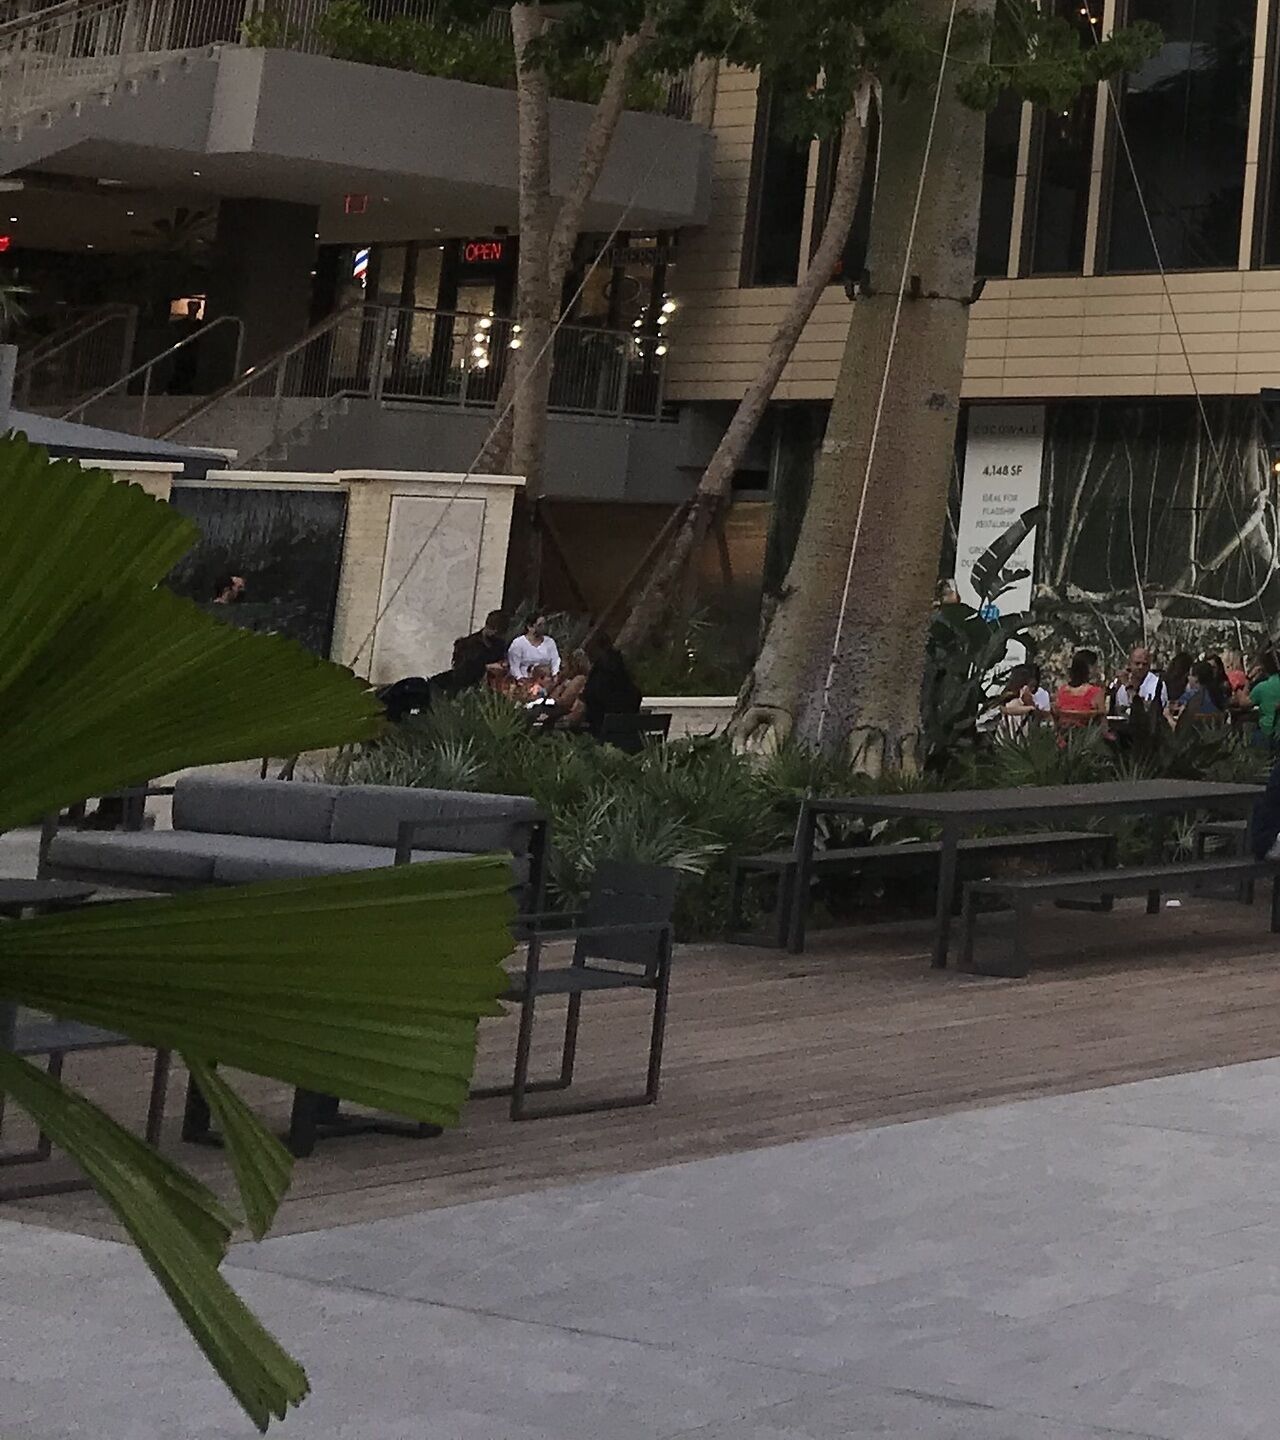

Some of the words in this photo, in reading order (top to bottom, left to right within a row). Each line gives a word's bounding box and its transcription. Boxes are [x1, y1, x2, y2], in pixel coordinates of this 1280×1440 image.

[465, 241, 502, 262] OPEN
[982, 464, 1009, 477] 4,148
[1011, 464, 1023, 476] SF
